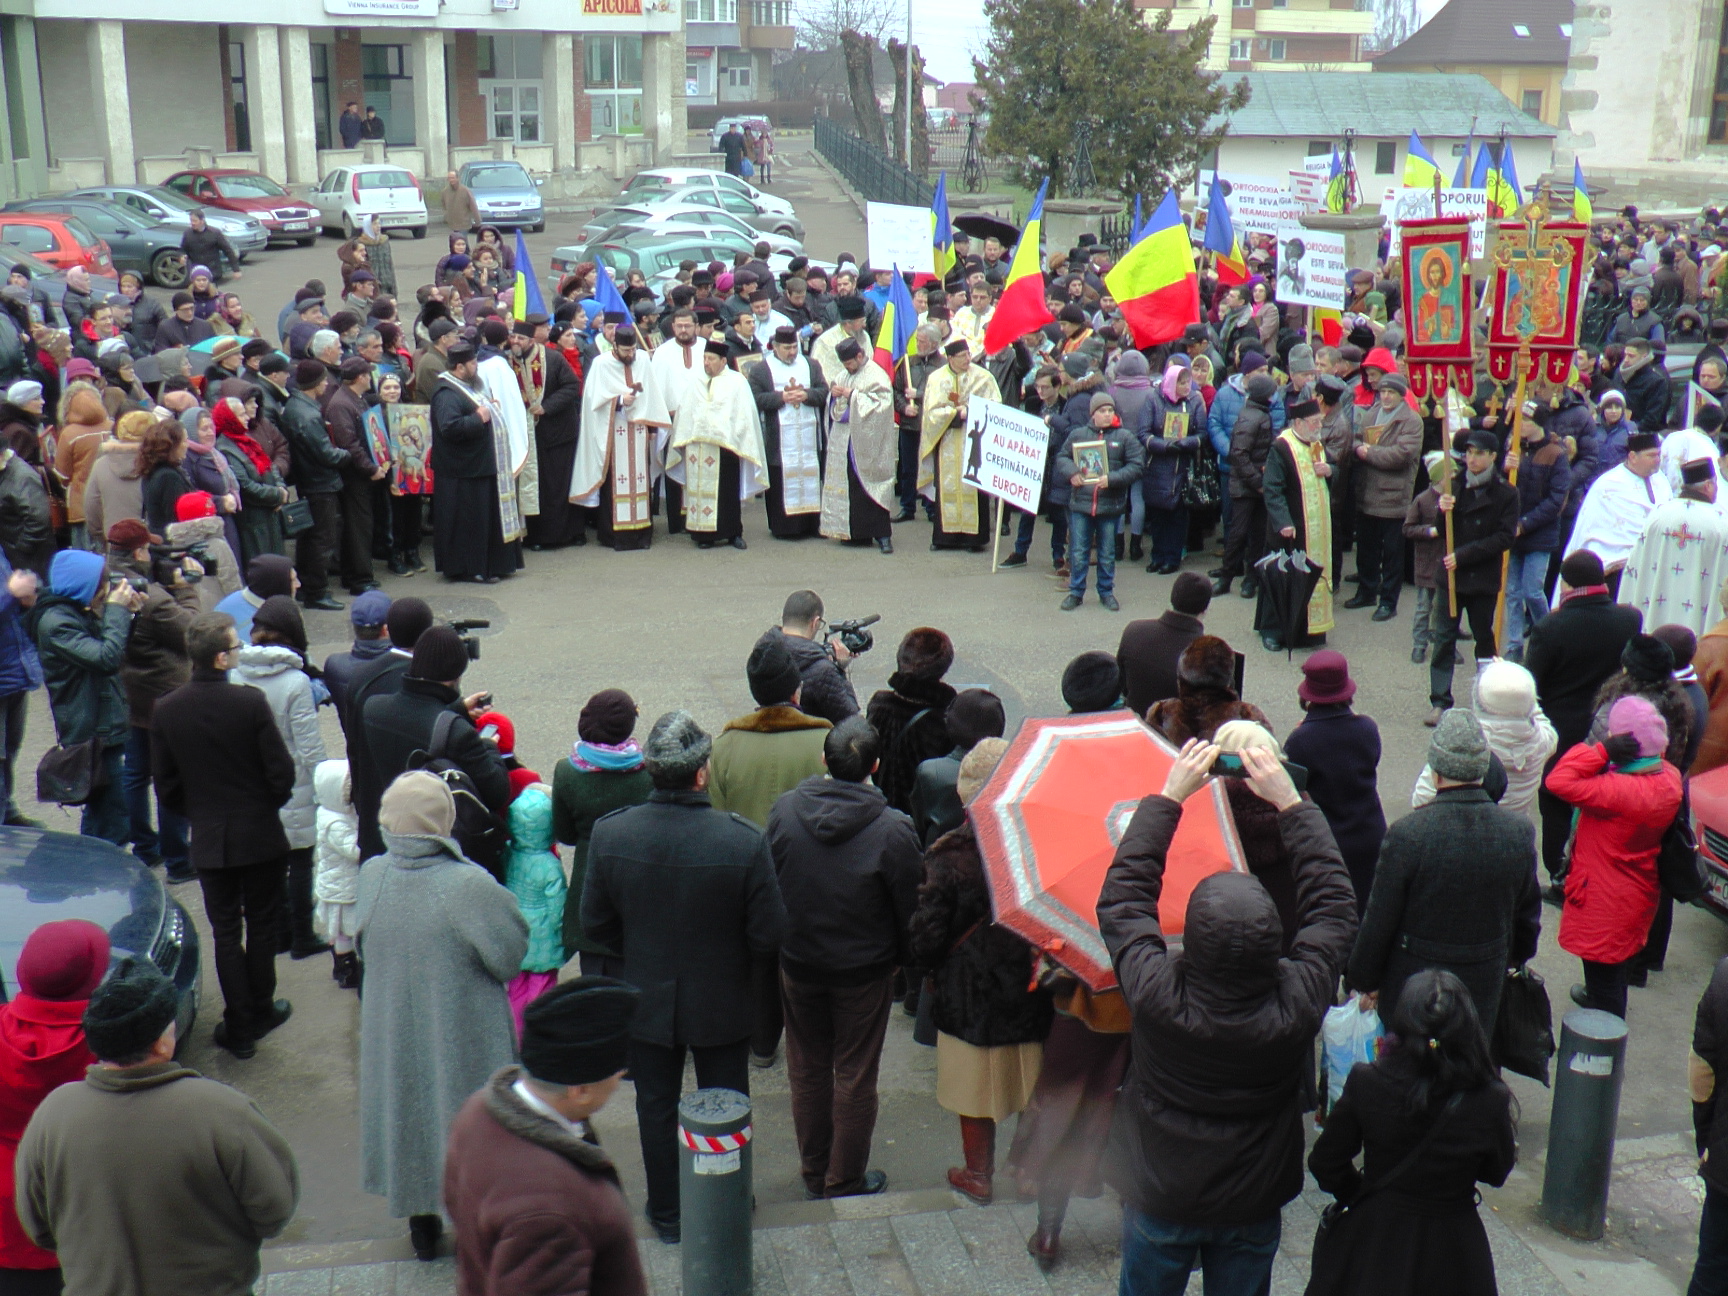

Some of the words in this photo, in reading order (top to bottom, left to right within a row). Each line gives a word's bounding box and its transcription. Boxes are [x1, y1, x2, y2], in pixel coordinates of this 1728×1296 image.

[584, 0, 641, 13] APICOLA
[1233, 183, 1279, 194] ORTODOXIA
[1239, 196, 1254, 204] ESTE
[1259, 198, 1278, 206] SEVA
[1306, 242, 1344, 255] ORTODOXIA
[1311, 258, 1325, 268] ESTE
[1328, 260, 1345, 270] SEVA
[1306, 288, 1344, 303] ROMÂNESC
[989, 413, 1022, 434] VOIEVOZII
[993, 433, 1005, 448] AU
[1007, 439, 1041, 461] APĂRAT
[992, 474, 1031, 503] EUROPEI
